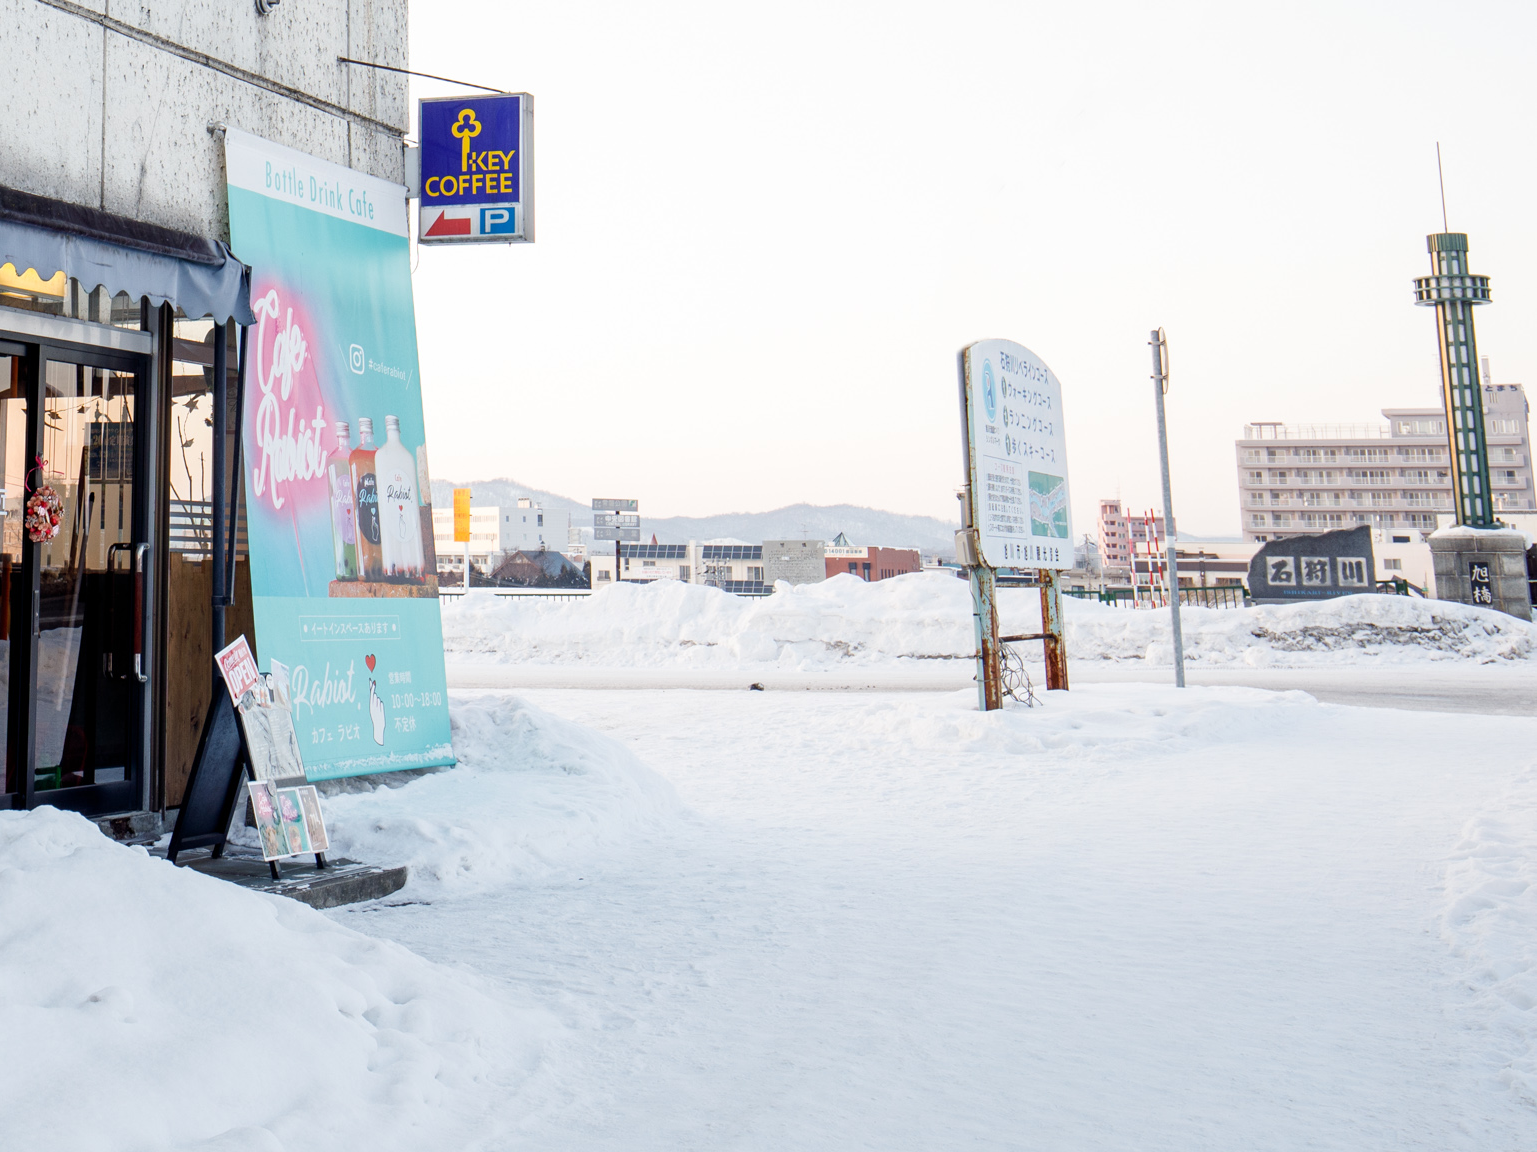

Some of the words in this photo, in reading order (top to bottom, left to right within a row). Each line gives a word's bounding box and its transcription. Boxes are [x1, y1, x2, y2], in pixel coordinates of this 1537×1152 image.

[469, 150, 515, 171] KEY
[265, 160, 304, 198] Bottle
[310, 175, 343, 211] Drink
[348, 188, 374, 220] Cafe
[425, 173, 513, 197] COFFEE
[485, 209, 509, 233] P
[1270, 559, 1364, 585] 石狩川
[1471, 565, 1493, 604] 旭橋
[311, 621, 389, 636] イートインスペースあります
[228, 657, 257, 697] OPEN
[388, 670, 412, 684] 営業時間
[312, 727, 333, 744] カフェ
[337, 724, 360, 741] ラビオ
[394, 715, 417, 732] 不定休
